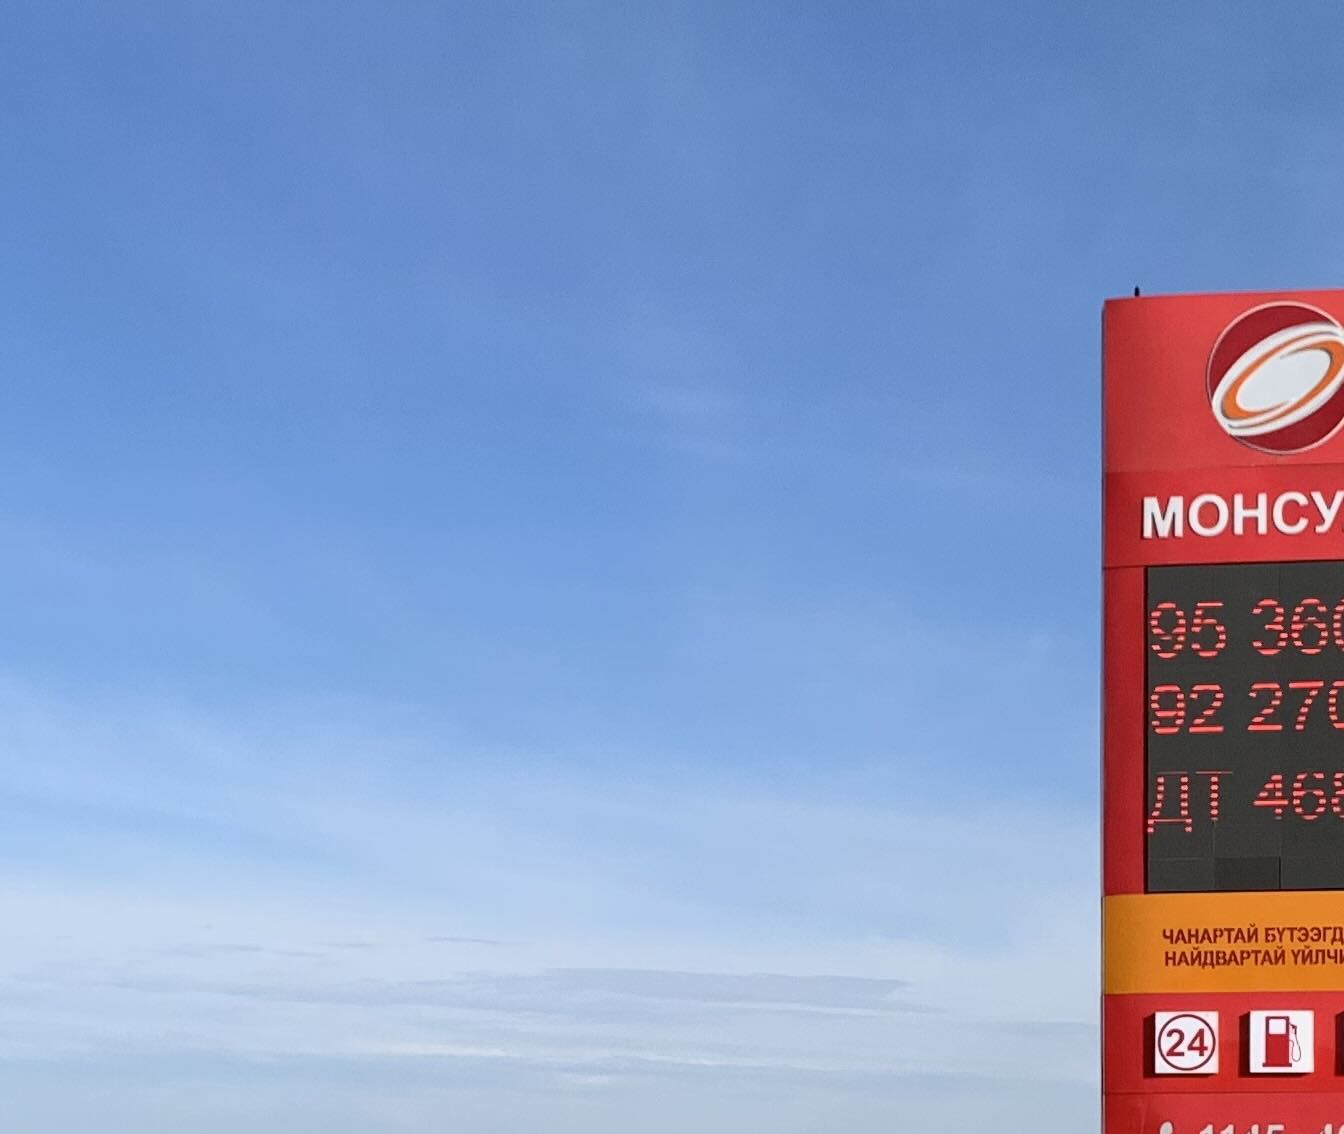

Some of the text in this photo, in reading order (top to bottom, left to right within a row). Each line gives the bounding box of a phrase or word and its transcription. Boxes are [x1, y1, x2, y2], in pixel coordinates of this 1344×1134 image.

[1149, 602, 1227, 659] 95
[1149, 684, 1224, 734] 92
[1147, 770, 1233, 833] ДТ
[1162, 923, 1258, 945] ЧАНАРТАЙ
[1164, 945, 1286, 969] НАЙДВАРТАЙ
[1166, 1028, 1208, 1057] 24
